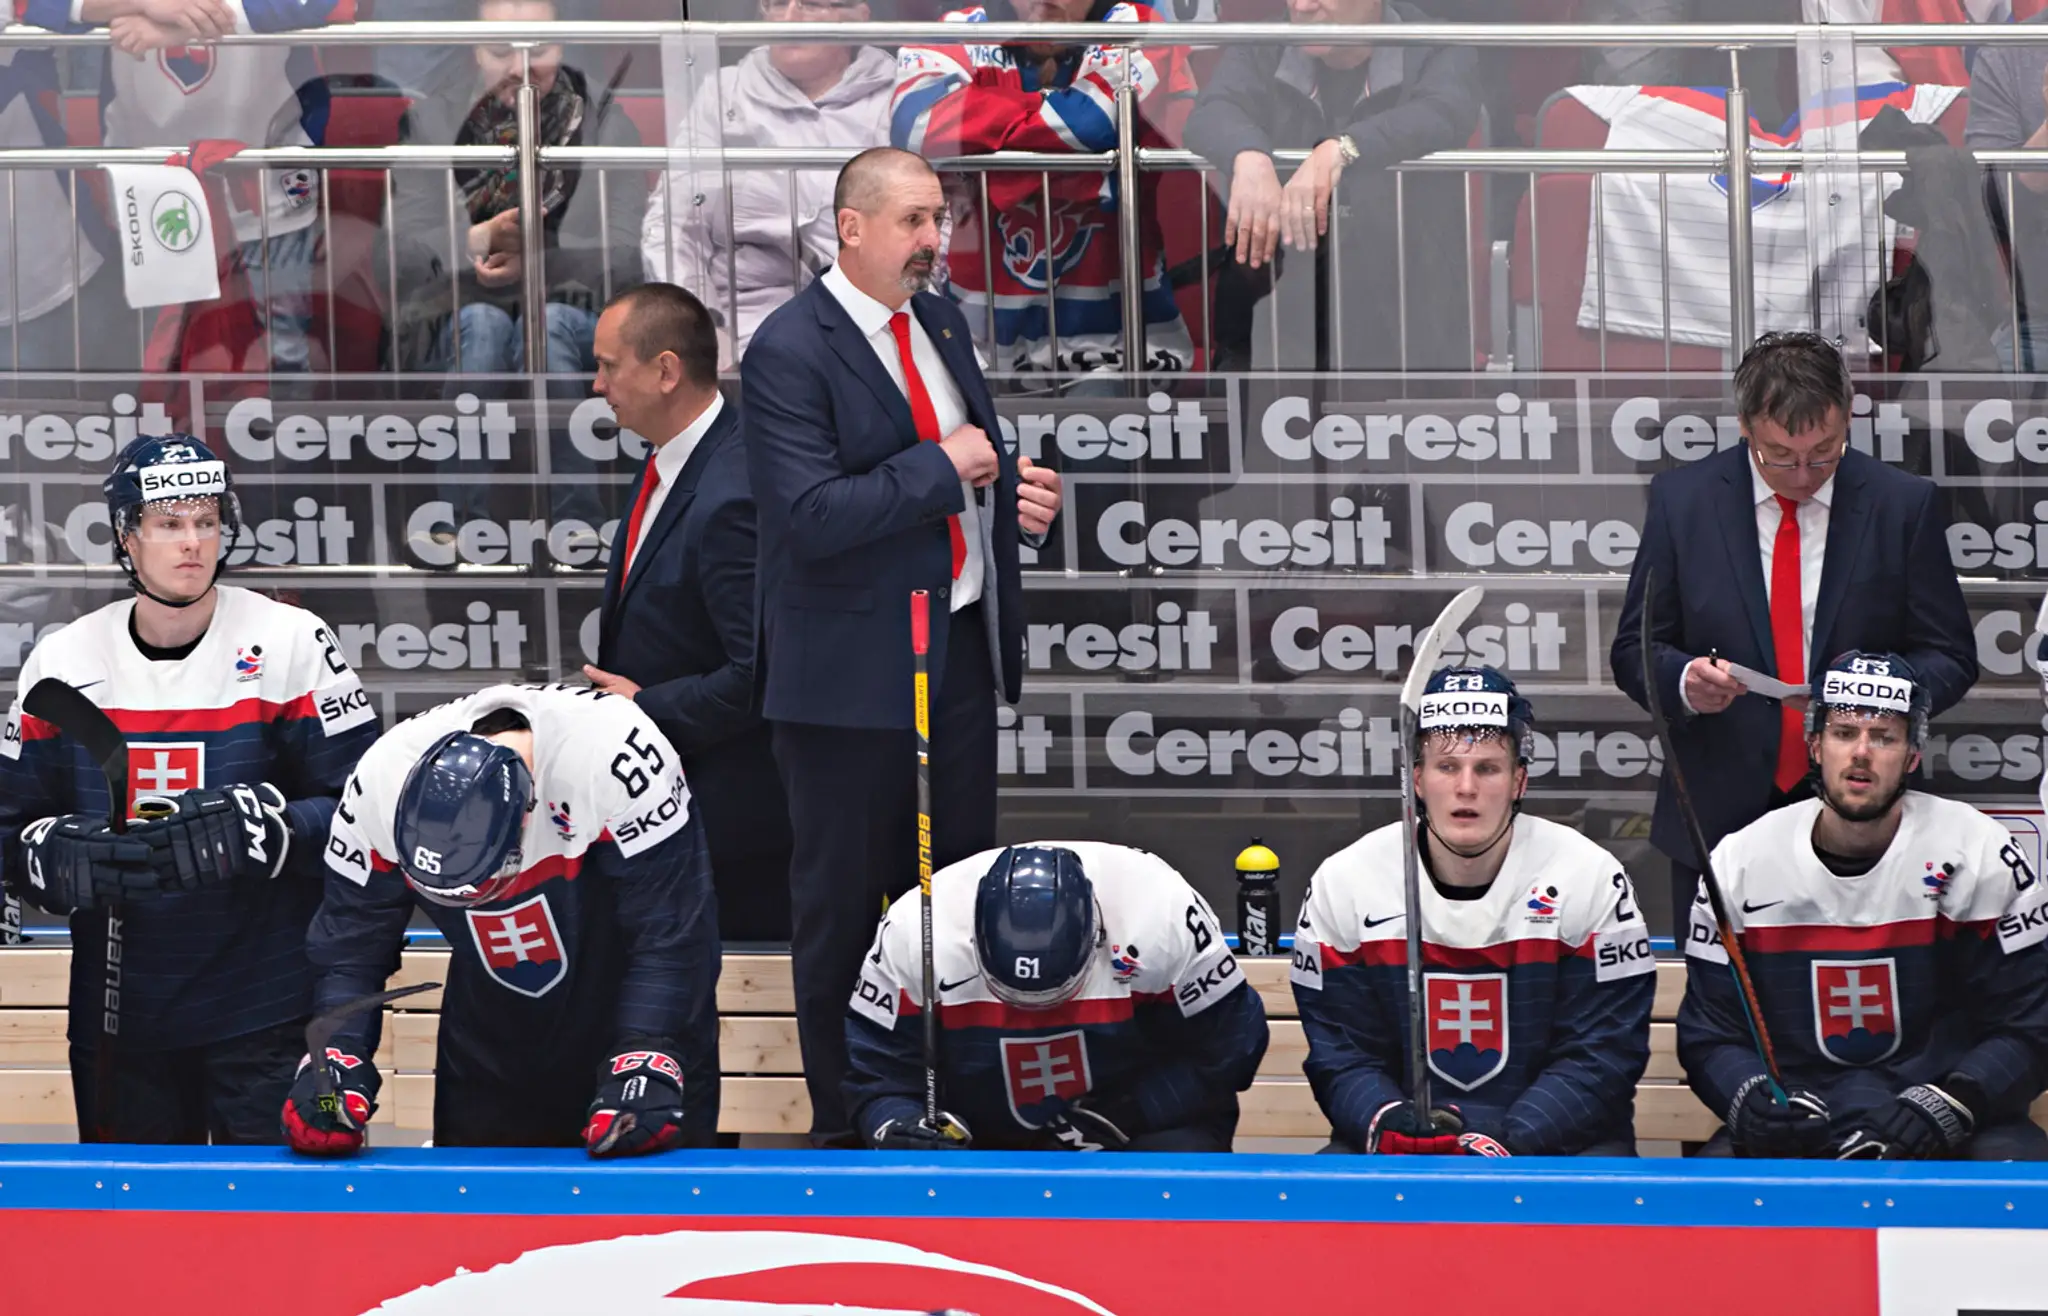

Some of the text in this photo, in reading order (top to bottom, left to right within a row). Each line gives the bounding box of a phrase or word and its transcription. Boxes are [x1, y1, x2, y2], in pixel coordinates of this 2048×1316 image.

[225, 393, 516, 461] Ceresit
[1261, 392, 1557, 461] Ceresit
[144, 470, 223, 491] ŠKODA
[1097, 497, 1391, 566] Ceresit
[1020, 602, 1218, 671] resit
[1849, 657, 1890, 676] 83
[1423, 701, 1506, 718] ŠKODA
[1444, 673, 1485, 691] 28
[1826, 677, 1907, 703] ŠKODA
[610, 727, 665, 799] 65
[1105, 707, 1399, 776] Ceresit
[615, 775, 686, 844] ŠKODA
[413, 846, 442, 875] 65
[918, 813, 933, 895] BAUER
[104, 916, 123, 1035] BAUER
[1014, 956, 1041, 980] 61
